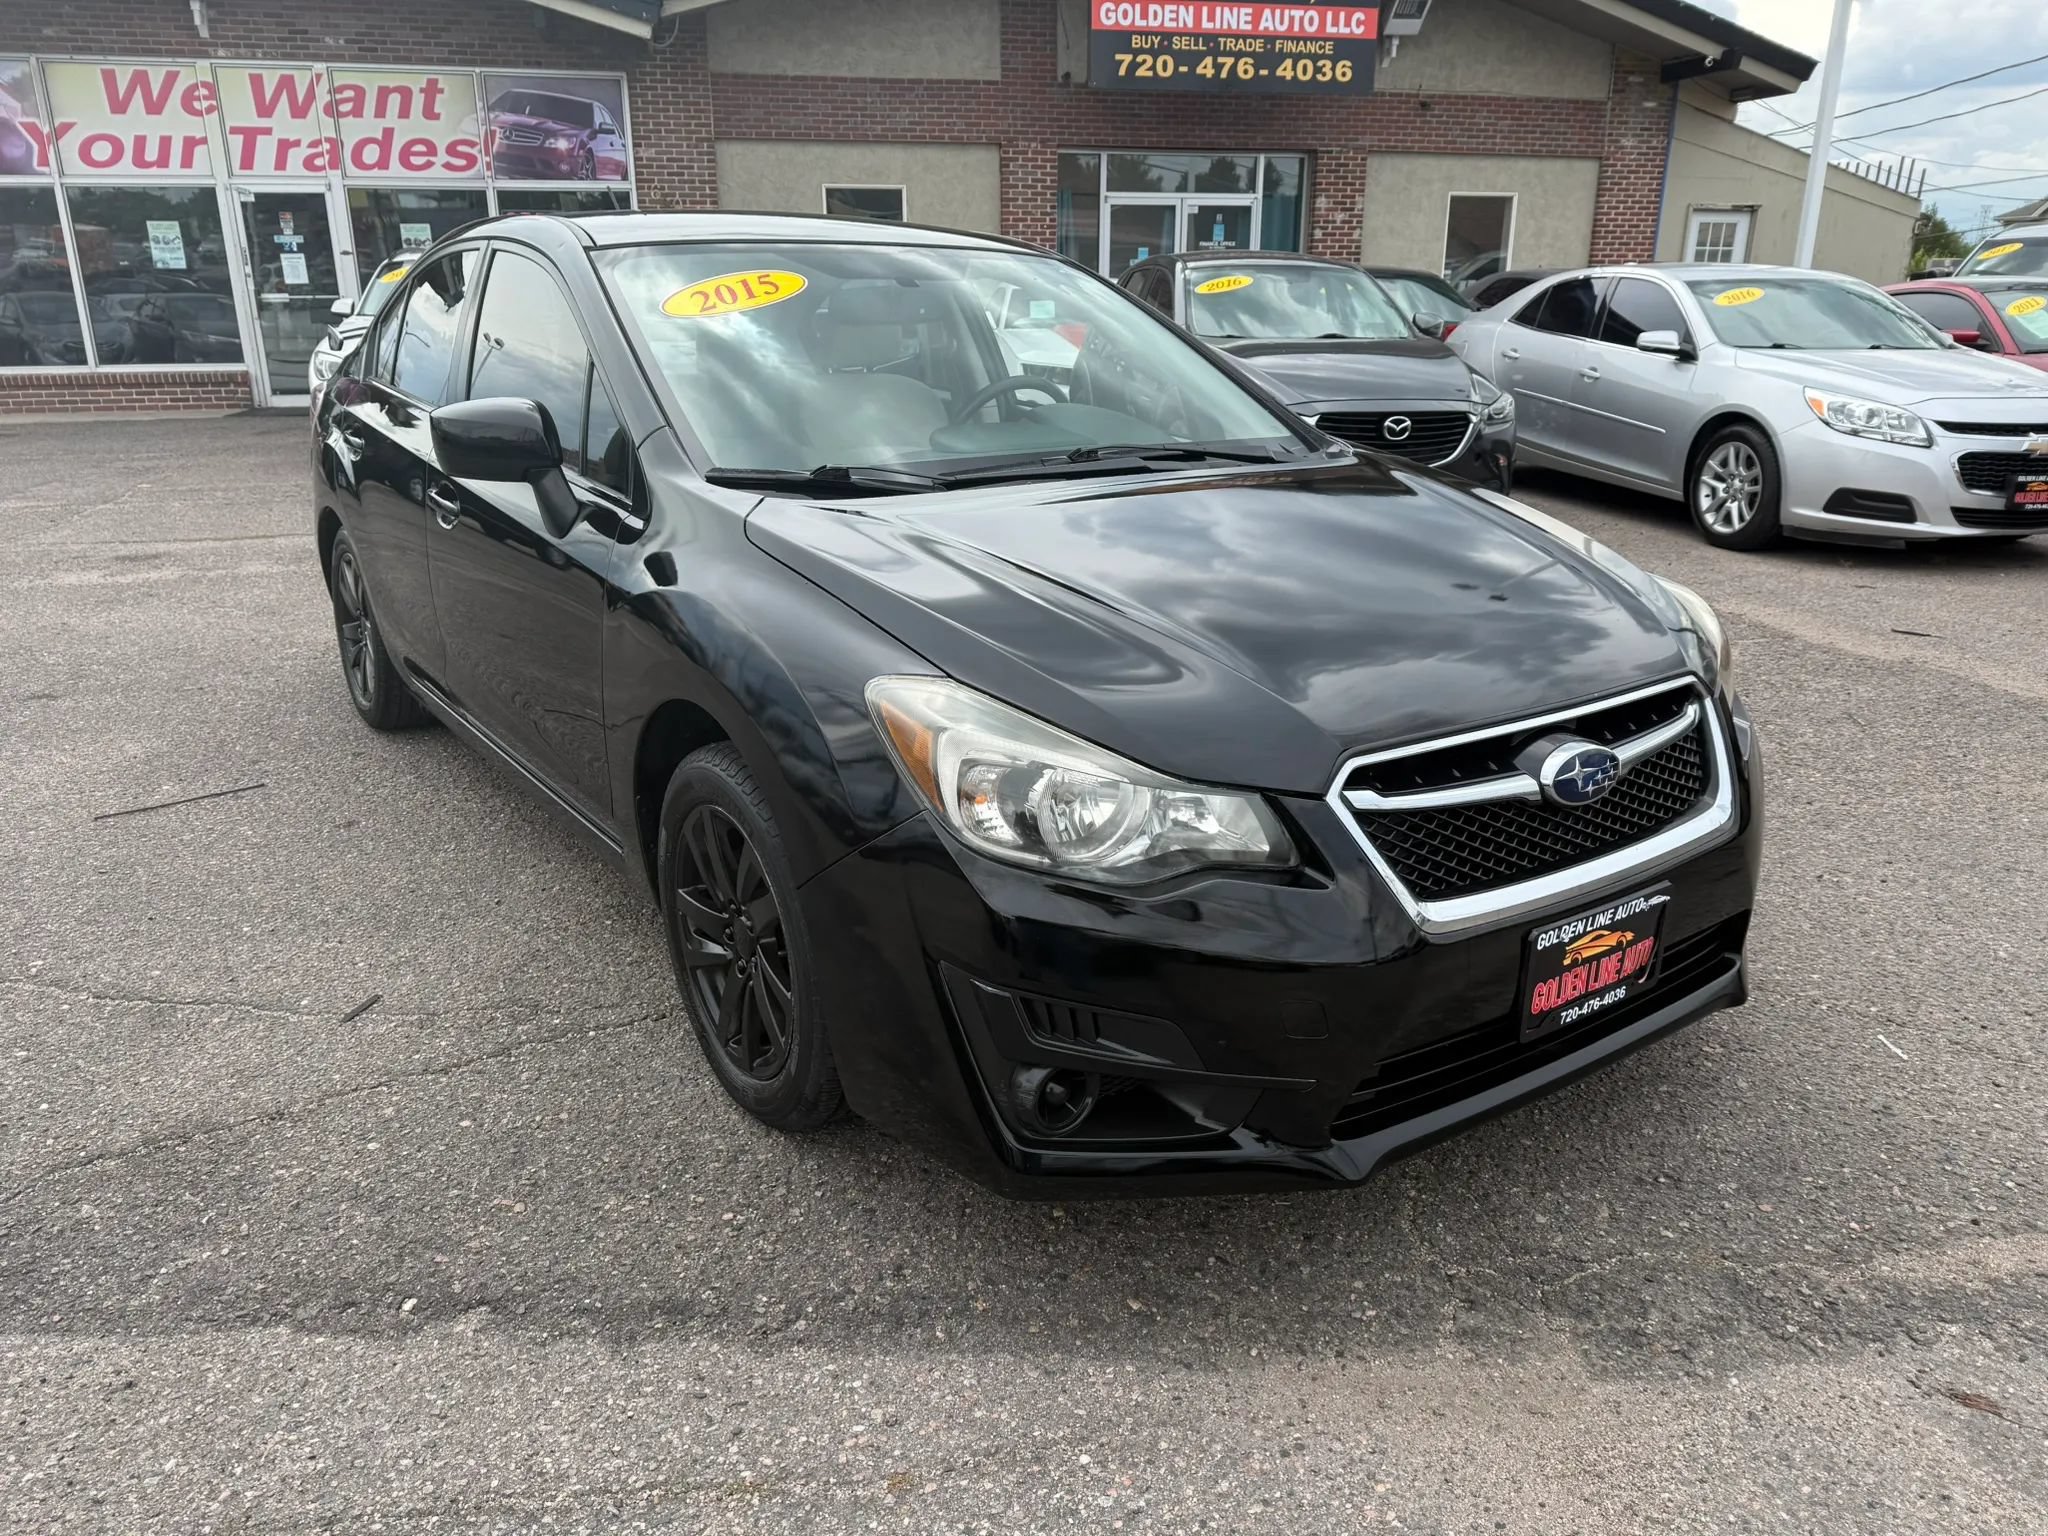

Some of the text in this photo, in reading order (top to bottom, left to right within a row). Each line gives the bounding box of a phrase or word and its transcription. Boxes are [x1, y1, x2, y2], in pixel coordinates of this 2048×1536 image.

[1099, 2, 1366, 34] GOLDEN LINE AUTO LLC
[1131, 34, 1335, 55] BUY SELL TRADE FINANCE
[100, 67, 445, 121] We Want
[18, 120, 497, 173] Your Trades!
[690, 273, 780, 313] 2015
[1206, 278, 1242, 292] 2016
[1722, 288, 1756, 305] 2016
[2012, 297, 2042, 313] 2011
[1537, 896, 1645, 951] GOLDEN LINE AUTO
[1531, 936, 1655, 1015] GOLDEN LINE AUTO
[1560, 985, 1627, 1025] 720-476-4036
